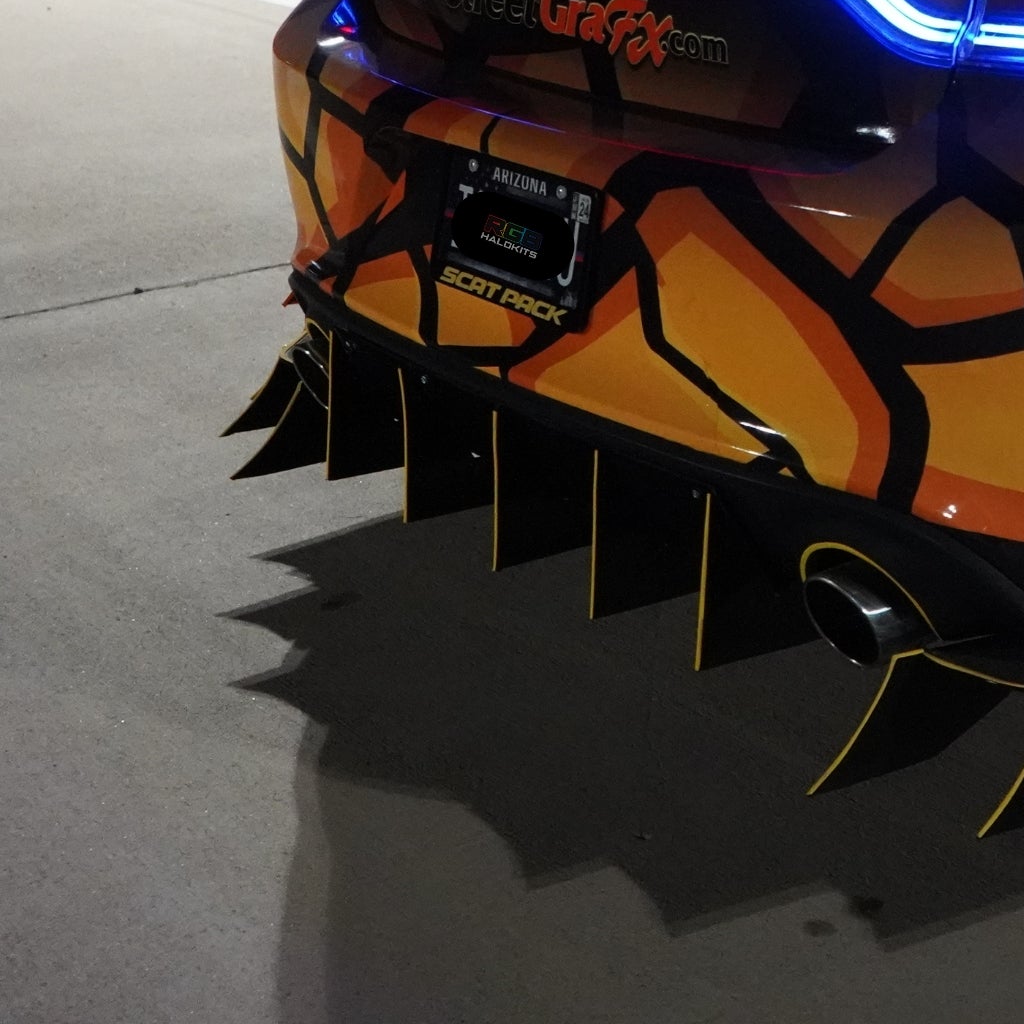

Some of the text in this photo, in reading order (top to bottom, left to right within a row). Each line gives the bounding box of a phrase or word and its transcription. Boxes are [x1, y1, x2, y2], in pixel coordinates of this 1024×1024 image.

[493, 167, 547, 196] ARIZONA
[440, 266, 501, 299] SCAT
[500, 289, 568, 326] PACK
